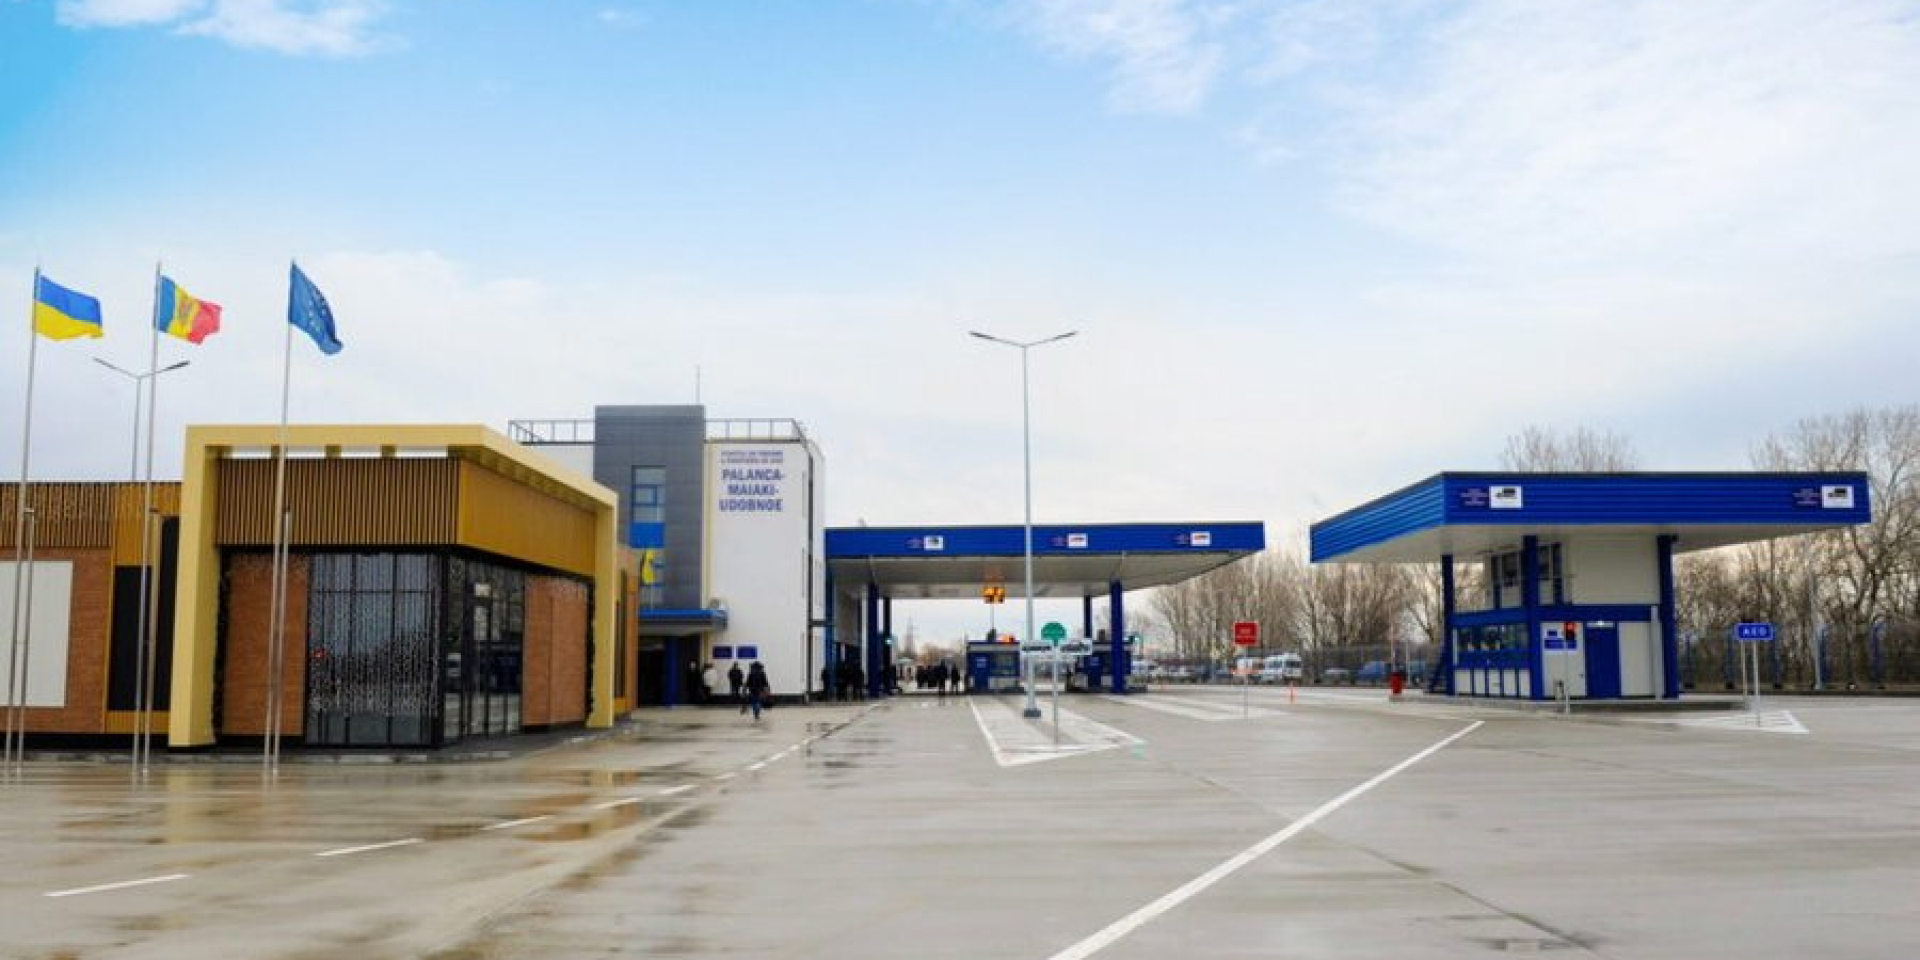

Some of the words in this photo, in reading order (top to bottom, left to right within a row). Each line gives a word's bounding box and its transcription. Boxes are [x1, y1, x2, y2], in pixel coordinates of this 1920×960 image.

[722, 469, 785, 480] PALANCA-
[727, 484, 779, 495] MAIAKI-
[719, 499, 783, 511] UDOBNOE
